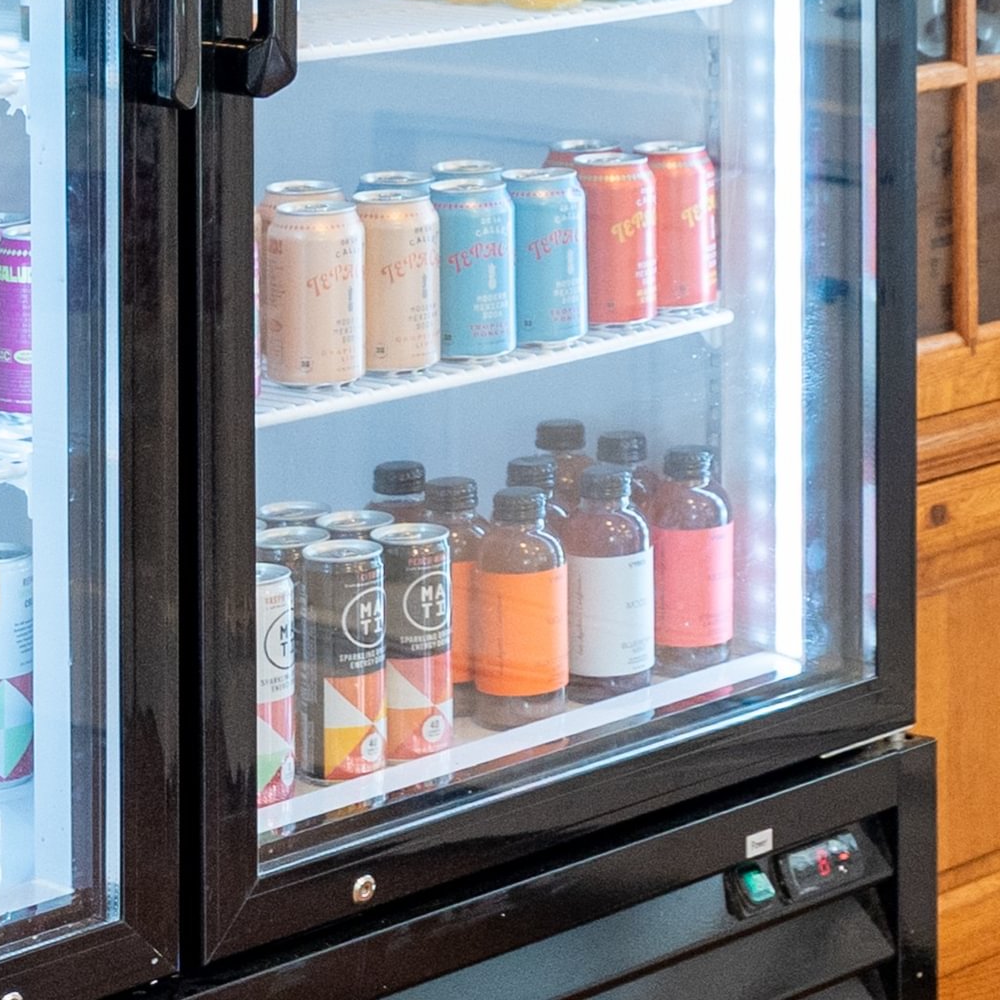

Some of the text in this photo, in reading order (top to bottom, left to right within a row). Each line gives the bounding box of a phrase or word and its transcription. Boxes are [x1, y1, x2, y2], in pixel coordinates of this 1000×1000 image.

[421, 583, 445, 602] MA
[421, 601, 445, 619] TI
[360, 617, 382, 636] TI
